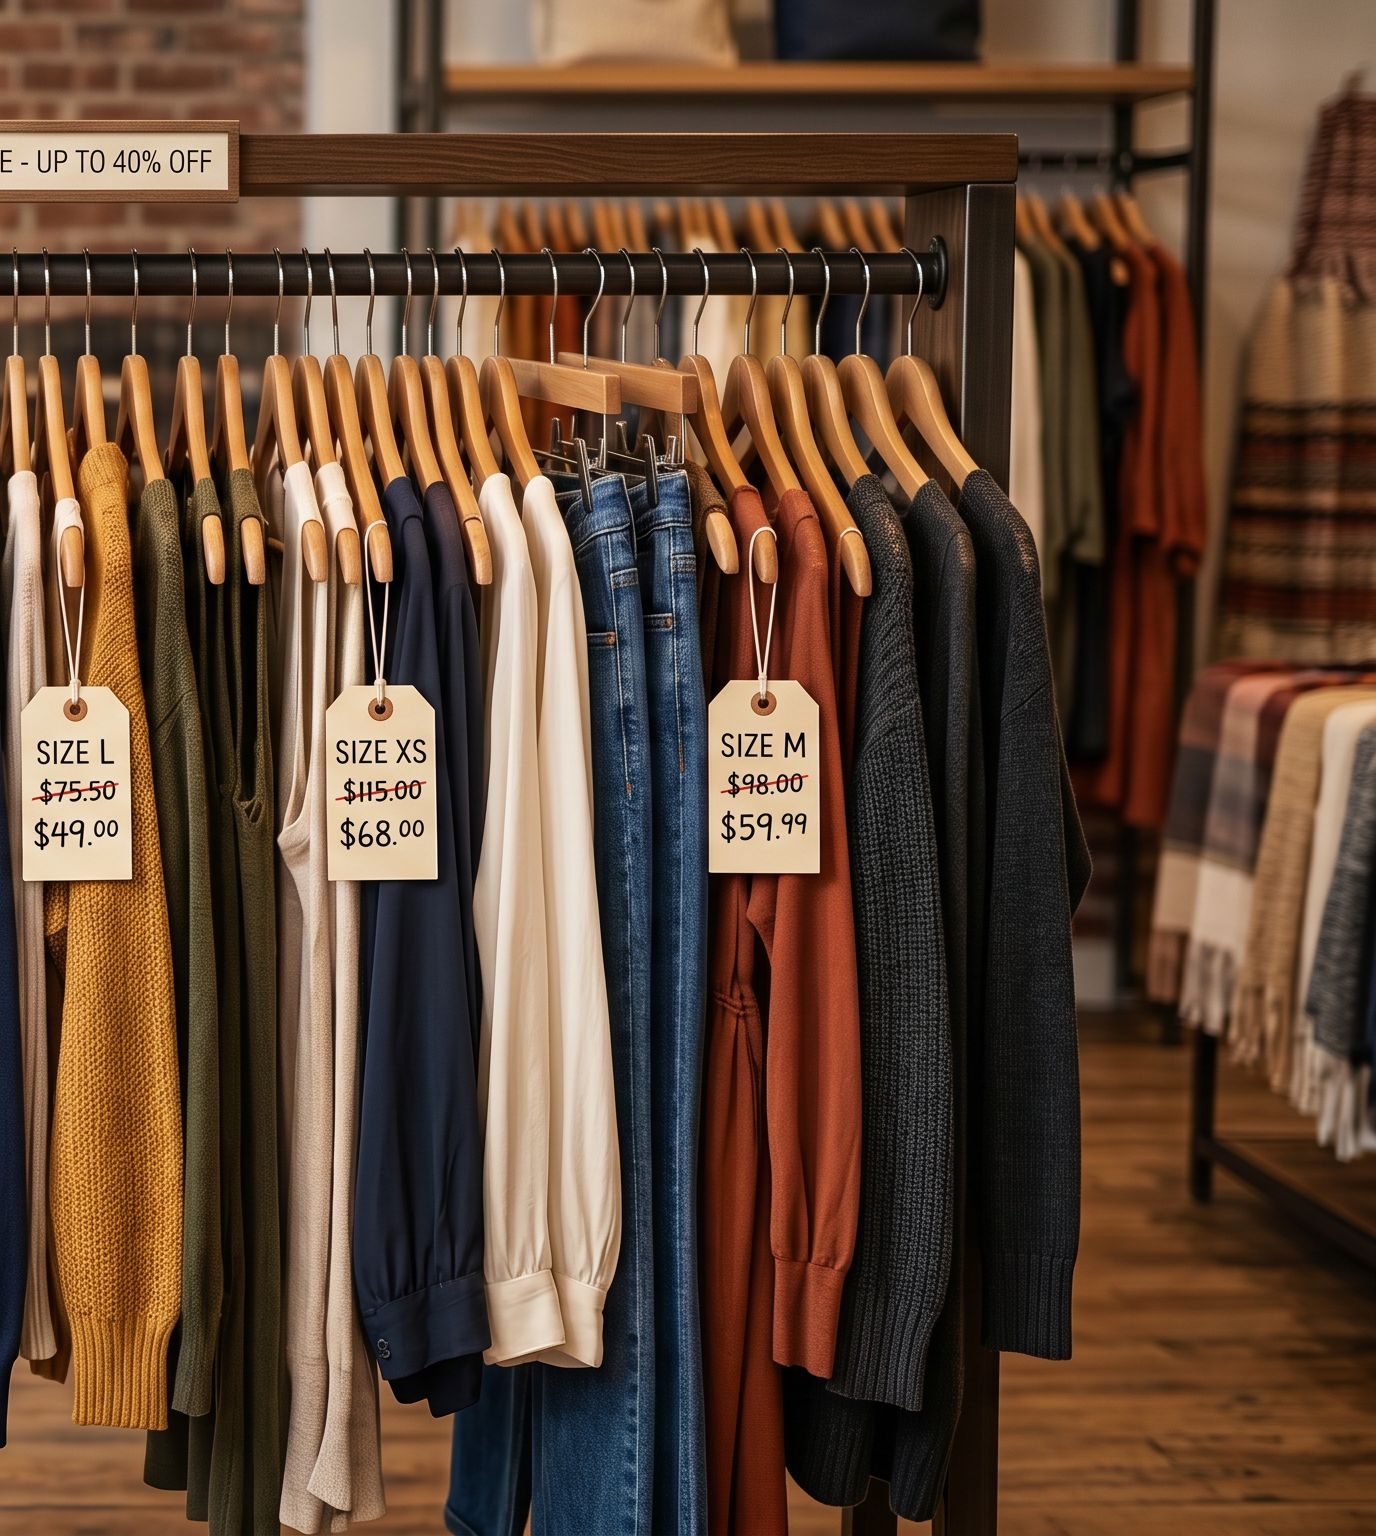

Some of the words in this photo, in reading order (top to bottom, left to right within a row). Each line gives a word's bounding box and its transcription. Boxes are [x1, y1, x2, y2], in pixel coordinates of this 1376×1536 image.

[37, 149, 68, 174] UP
[75, 149, 105, 174] TO
[112, 149, 161, 174] 40%
[169, 149, 212, 174] OFF
[37, 739, 90, 765] SIZE
[100, 738, 115, 765] L
[336, 739, 388, 765] SIZE
[395, 738, 427, 764] XS
[721, 732, 774, 758] SIZE
[784, 732, 806, 759] M
[38, 778, 116, 806] $75.50
[343, 777, 422, 805] $115.00
[727, 771, 804, 799] $98.00
[34, 817, 119, 851] $49.00
[340, 817, 425, 850] $68.00
[721, 810, 807, 844] $59.99
